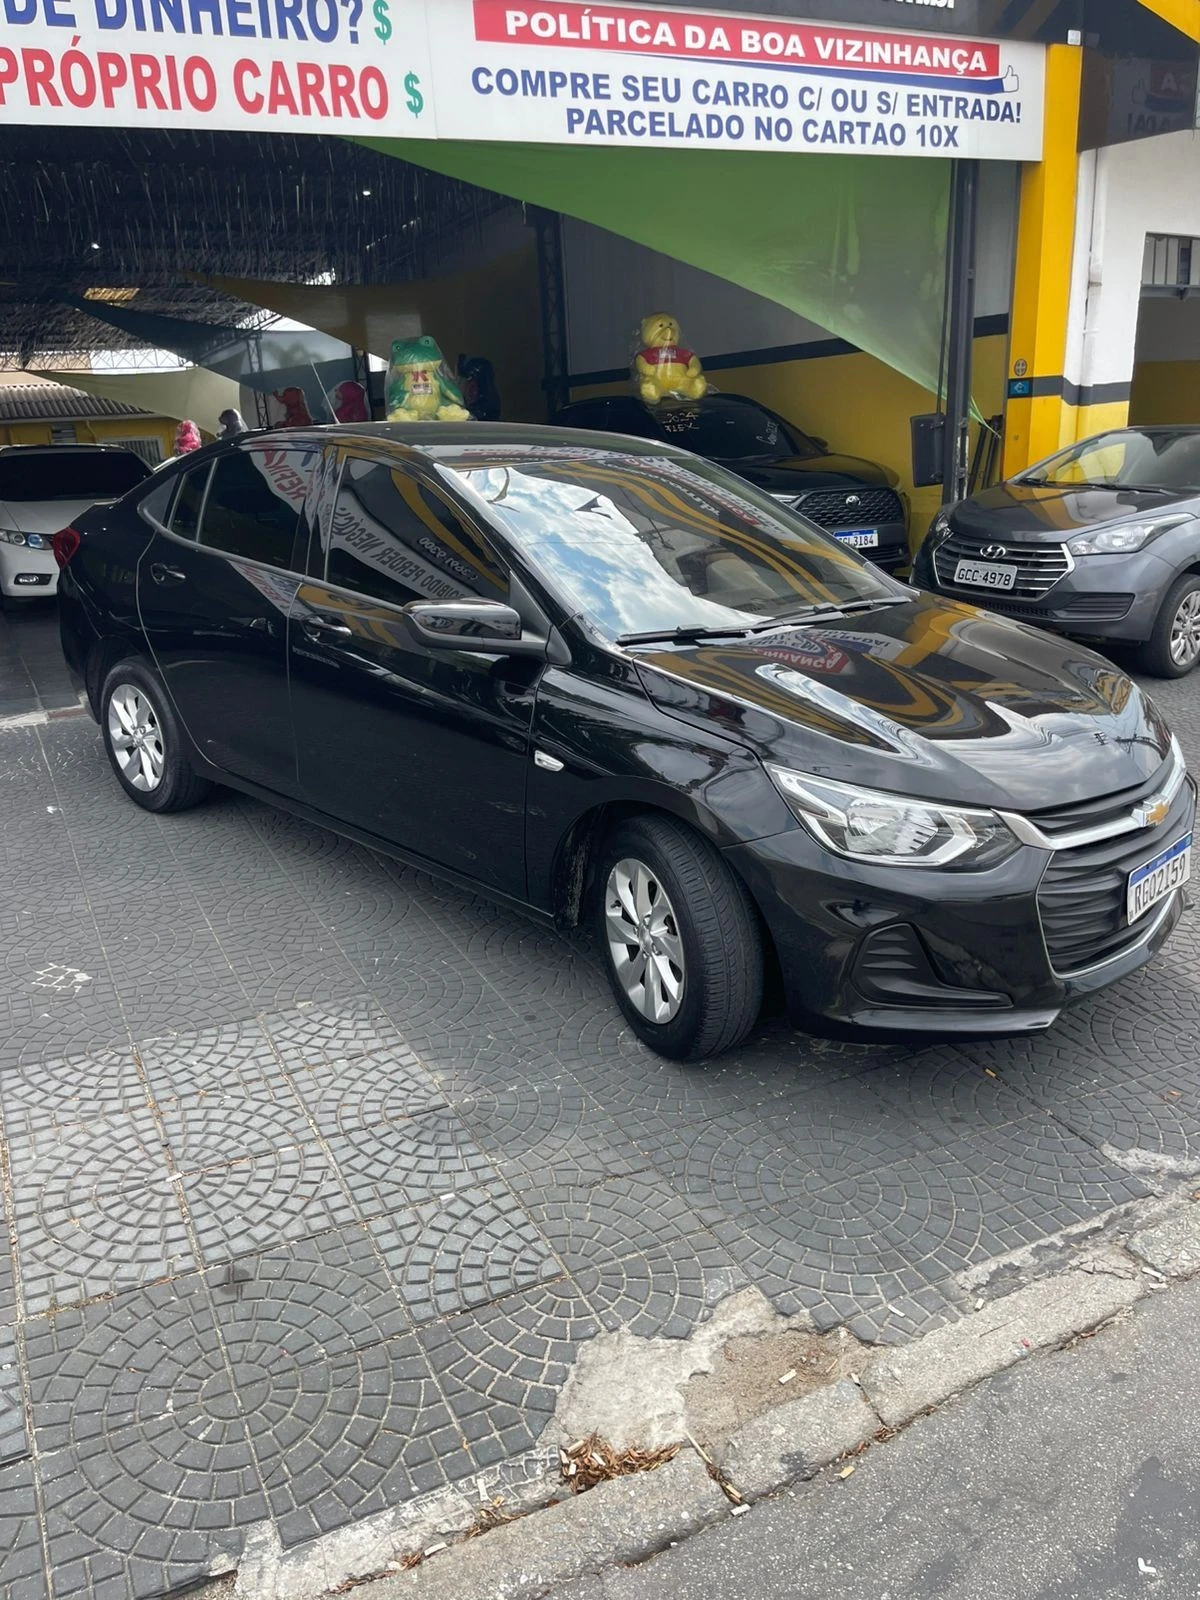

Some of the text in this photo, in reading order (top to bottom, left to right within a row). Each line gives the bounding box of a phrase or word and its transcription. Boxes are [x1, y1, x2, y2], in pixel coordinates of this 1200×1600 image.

[505, 9, 987, 75] POLÍTICA DA BOA VIZINHANÇA
[0, 35, 217, 112] PRÓPRIO
[233, 58, 388, 120] CARRO
[471, 66, 1021, 123] COMPRE SEU CARRO C/ OU S/ ENTRADA!
[566, 108, 959, 147] PARCELADO NO CARTAO 10X
